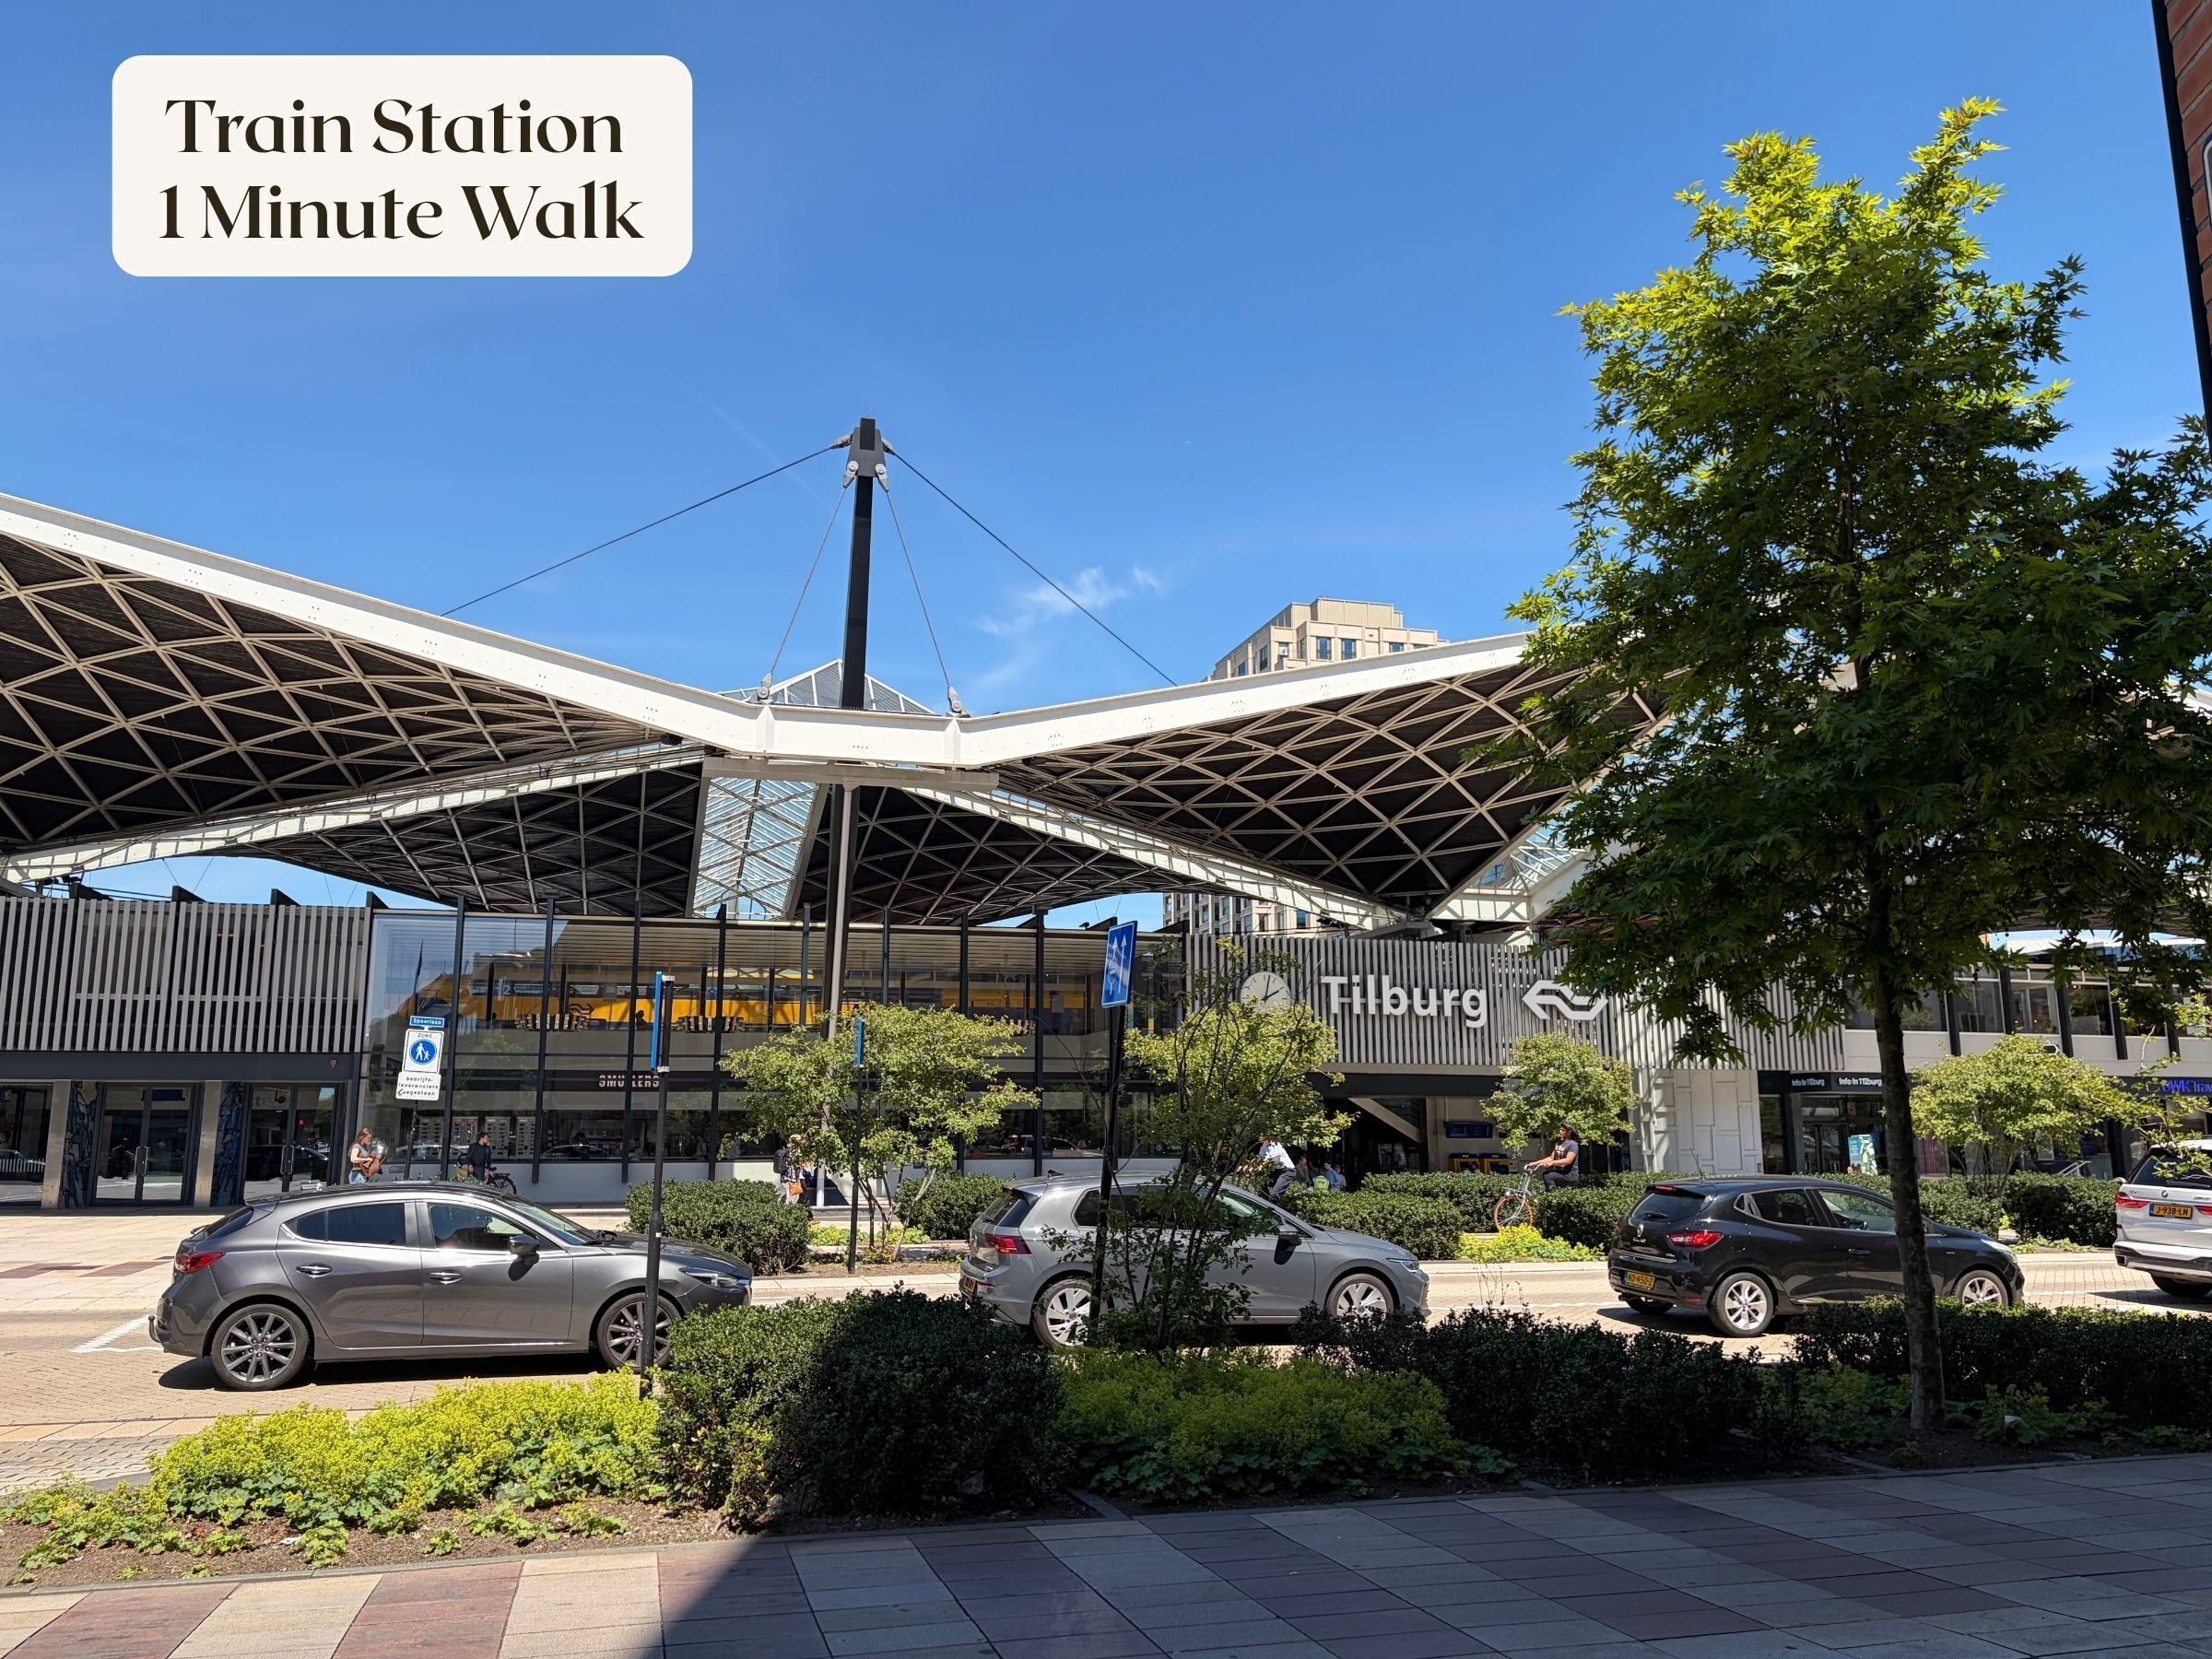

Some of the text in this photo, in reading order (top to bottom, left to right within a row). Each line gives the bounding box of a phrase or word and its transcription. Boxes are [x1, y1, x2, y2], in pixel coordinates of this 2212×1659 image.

[1321, 974, 1488, 1028] Tilburg
[599, 1075, 660, 1088] SMULERS
[1858, 1077, 1882, 1087] Tilburg
[2157, 1206, 2189, 1216] J-938-LN
